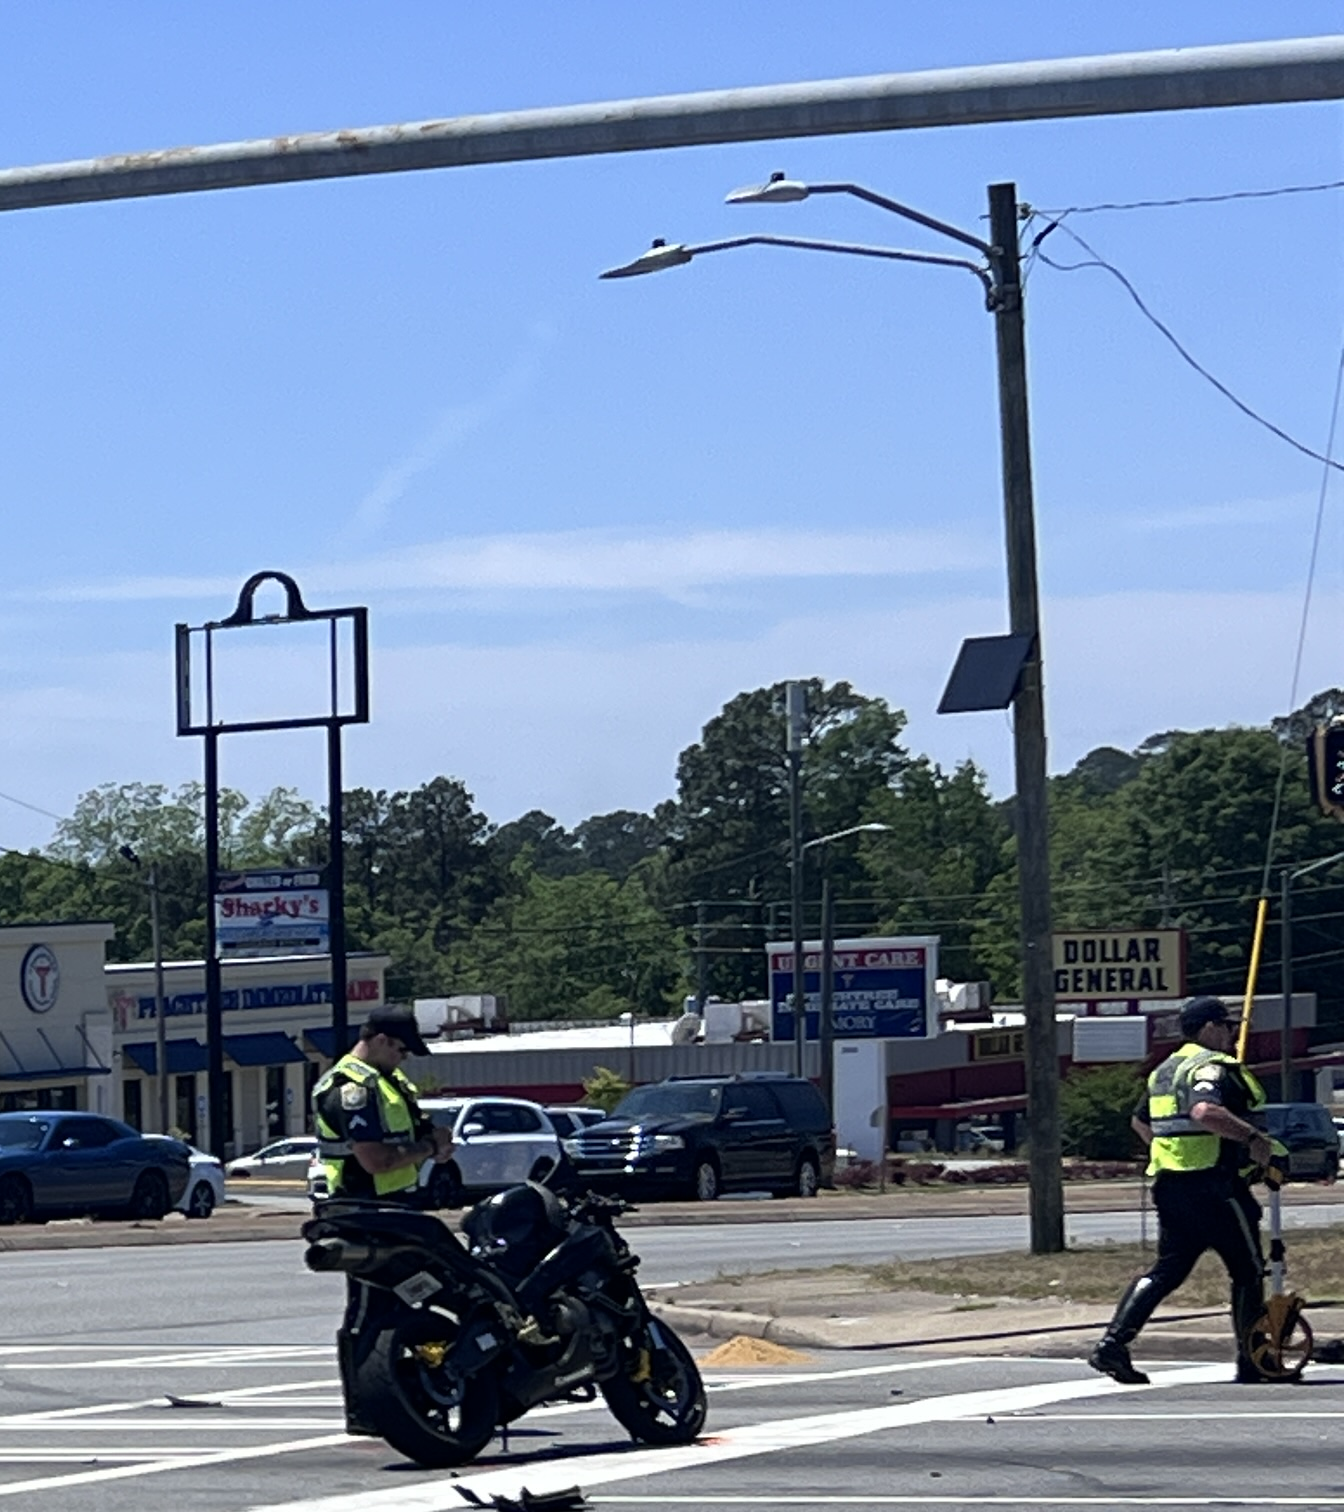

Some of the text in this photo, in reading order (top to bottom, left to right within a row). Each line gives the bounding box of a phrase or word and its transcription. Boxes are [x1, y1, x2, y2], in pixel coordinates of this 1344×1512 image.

[221, 895, 320, 919] Sharky's
[864, 951, 920, 967] CARE
[1063, 938, 1161, 964] DOLLAR
[1053, 967, 1169, 993] GENERAL
